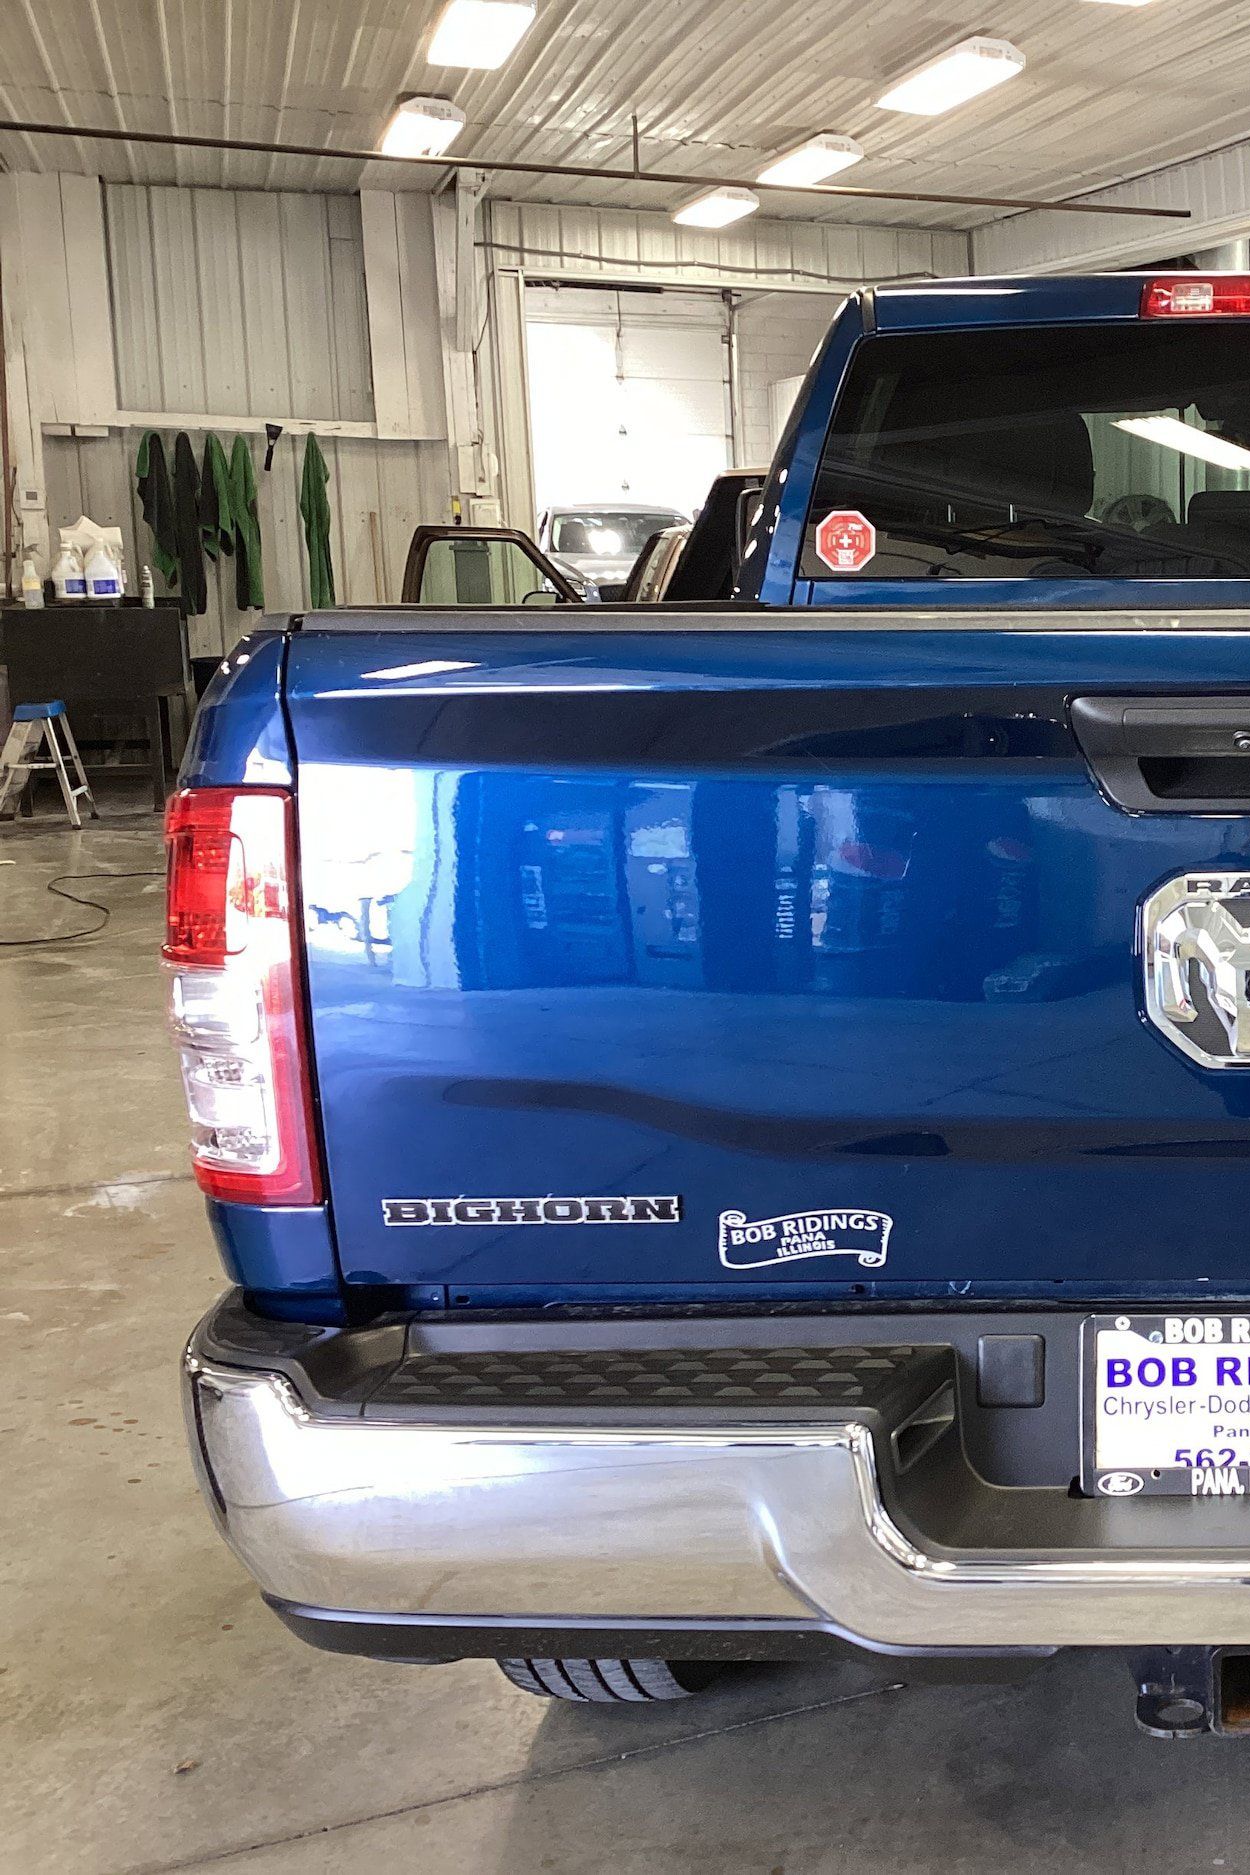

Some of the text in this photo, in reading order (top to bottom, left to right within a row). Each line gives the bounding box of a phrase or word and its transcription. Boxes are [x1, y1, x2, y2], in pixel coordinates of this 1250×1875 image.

[730, 1214, 879, 1246] BOB RIDINGS
[780, 1231, 826, 1247] PANA
[776, 1240, 836, 1258] ILLINOIS
[1164, 1316, 1224, 1344] BOB
[1106, 1357, 1198, 1388] BOB
